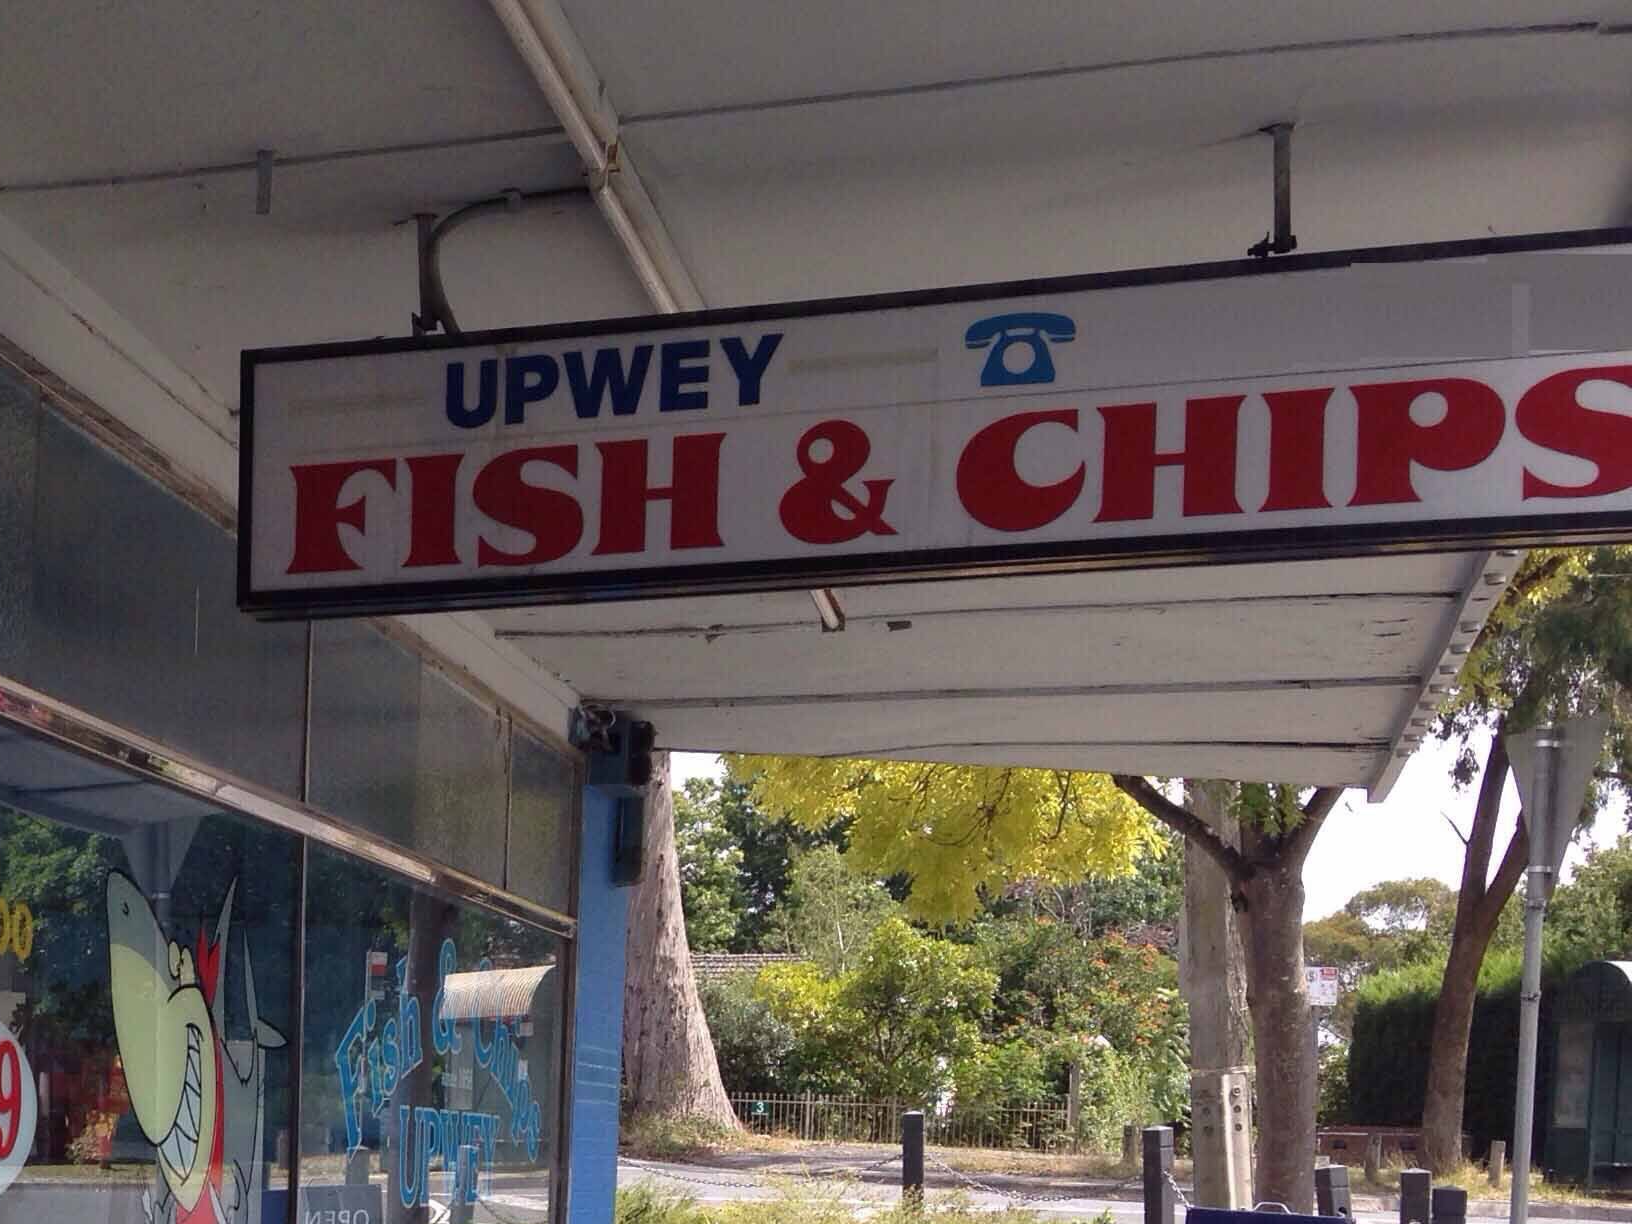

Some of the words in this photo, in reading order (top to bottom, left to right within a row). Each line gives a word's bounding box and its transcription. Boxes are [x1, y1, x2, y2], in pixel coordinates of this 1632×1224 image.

[445, 330, 785, 430] UPWEY
[286, 430, 728, 576] FISH
[779, 418, 896, 546] &
[955, 364, 1632, 532] CHIPS
[335, 953, 423, 1160] Fish
[756, 1102, 765, 1113] 3
[399, 1104, 501, 1210] UPWEY
